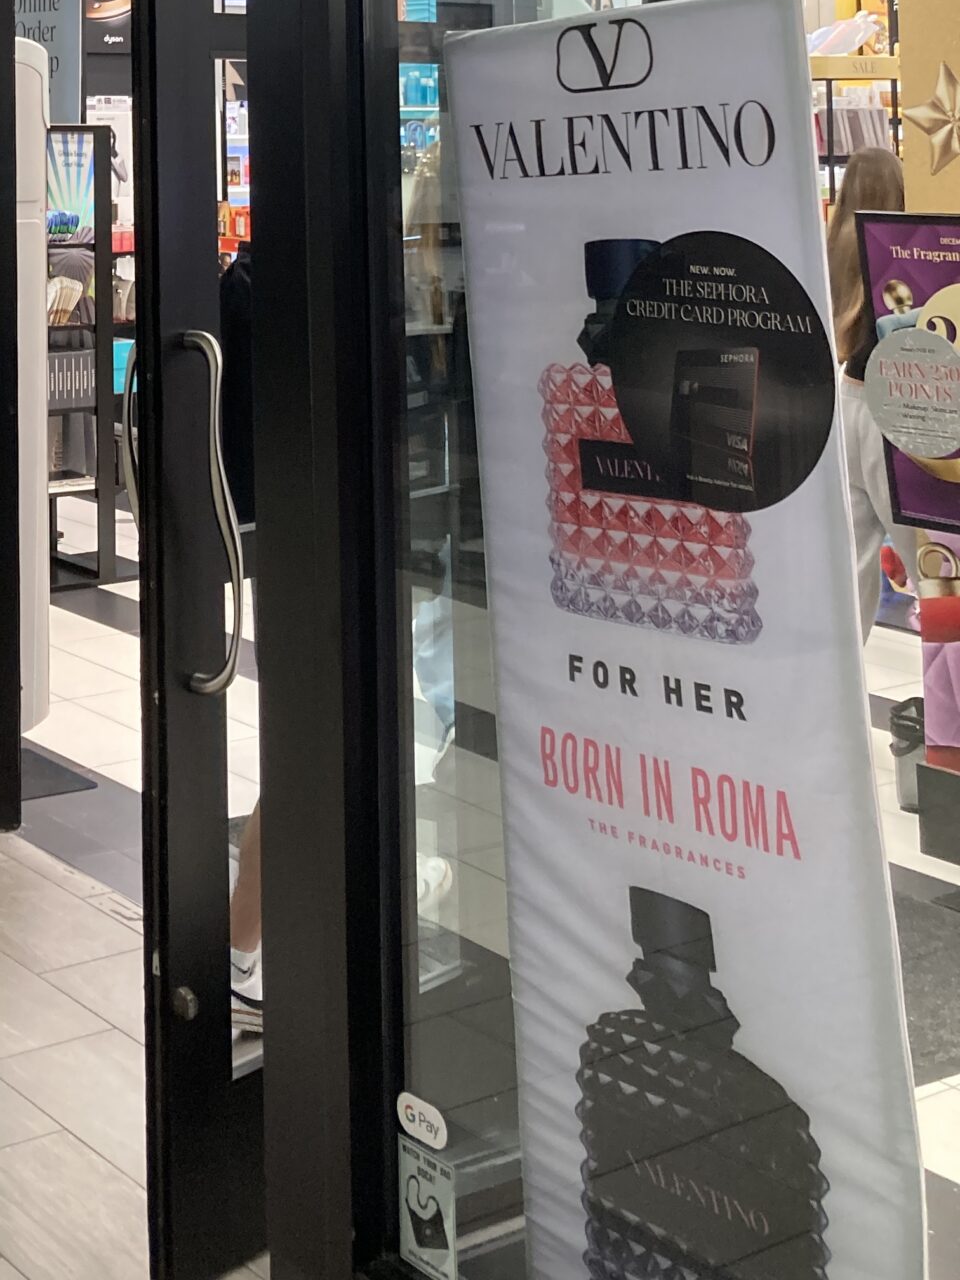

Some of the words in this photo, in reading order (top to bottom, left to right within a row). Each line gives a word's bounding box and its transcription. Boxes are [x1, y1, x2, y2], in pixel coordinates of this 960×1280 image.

[104, 34, 124, 45] dyson
[852, 62, 877, 74] SALE
[470, 100, 776, 180] VALENTINO
[890, 245, 911, 259] The
[690, 265, 711, 275] NEW.
[713, 267, 737, 277] NOW.
[662, 278, 693, 298] THE
[696, 282, 770, 304] SEPHORA
[626, 298, 678, 320] CREDIT
[681, 304, 724, 326] CARD
[728, 308, 812, 334] PROGRAM
[720, 354, 754, 364] SEPHORA
[880, 360, 926, 379] EARN
[888, 381, 953, 402] POINTS
[727, 432, 748, 452] VISA
[568, 654, 639, 697] FOR
[663, 675, 747, 721] HER
[541, 726, 624, 809] BORN
[640, 753, 675, 824] IN
[691, 767, 801, 860] ROMA
[588, 818, 619, 839] THE
[628, 831, 746, 880] FRAGRANCES
[404, 1104, 416, 1123] G
[418, 1112, 440, 1140] Pay
[626, 1149, 770, 1235] VALENTINO
